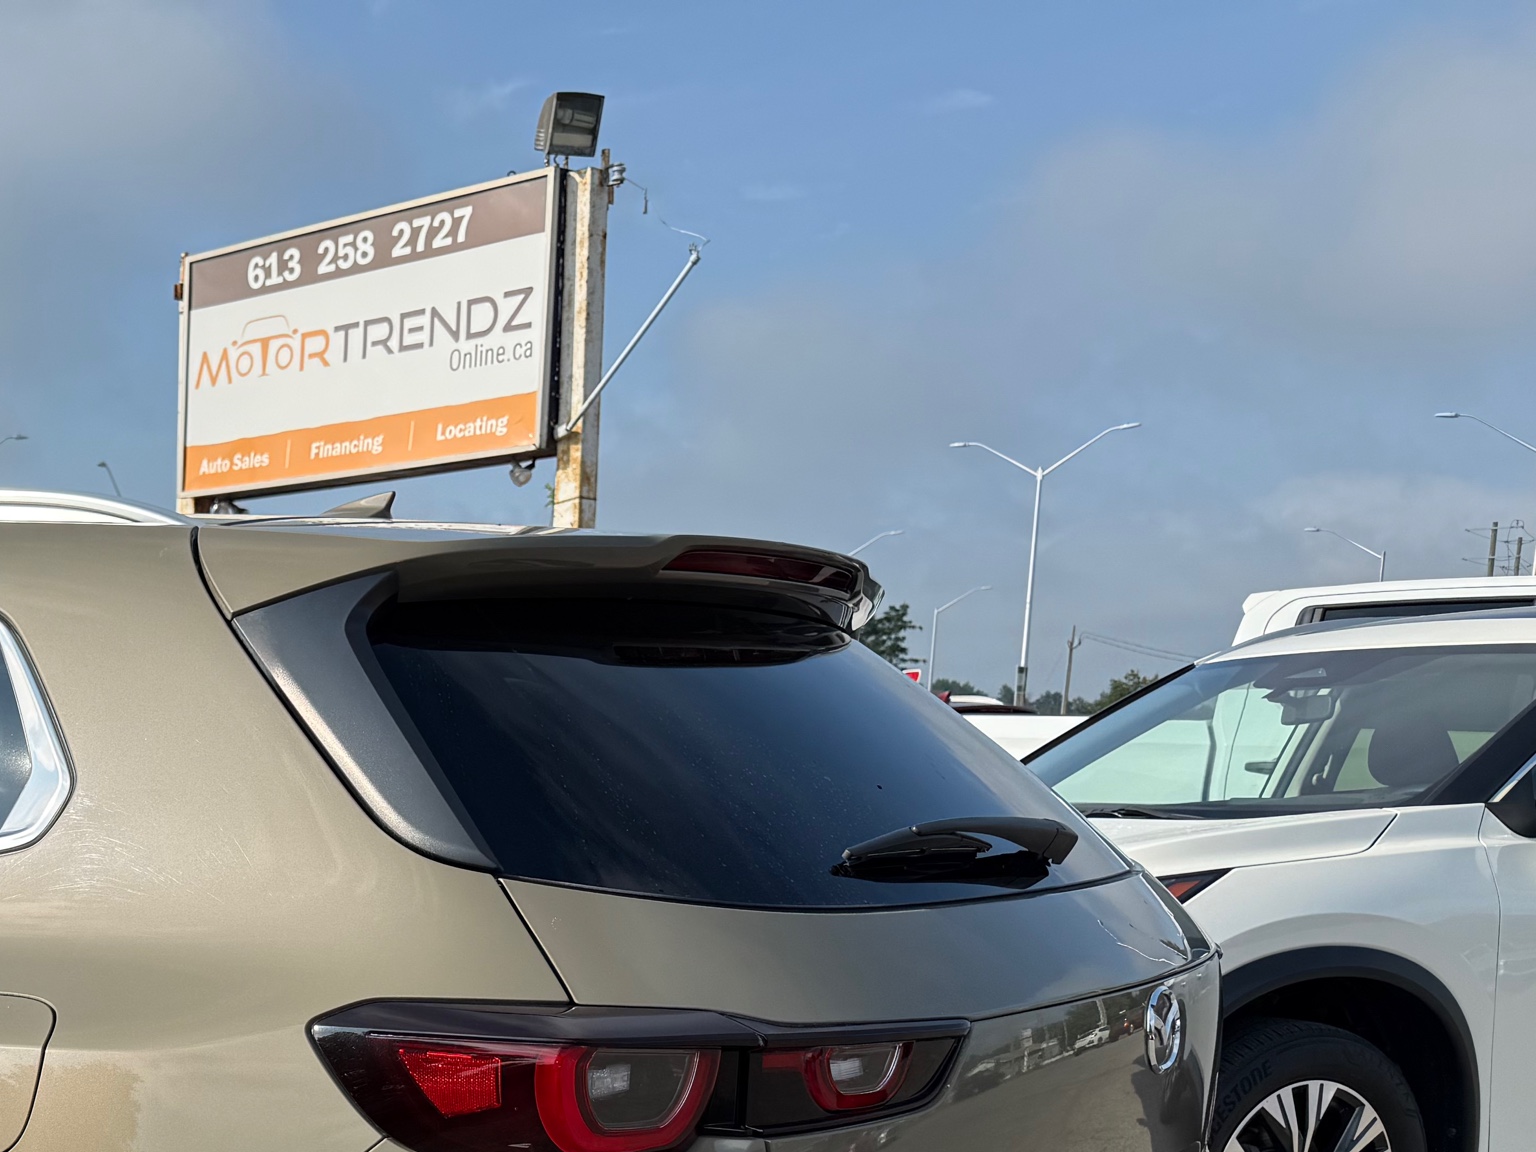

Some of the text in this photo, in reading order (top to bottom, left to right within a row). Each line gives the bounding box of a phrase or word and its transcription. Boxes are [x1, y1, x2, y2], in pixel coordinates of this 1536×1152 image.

[247, 205, 473, 290] 613 258 2727
[449, 340, 534, 372] Online.ca
[199, 414, 509, 476] Auto Sales Financing Locating
